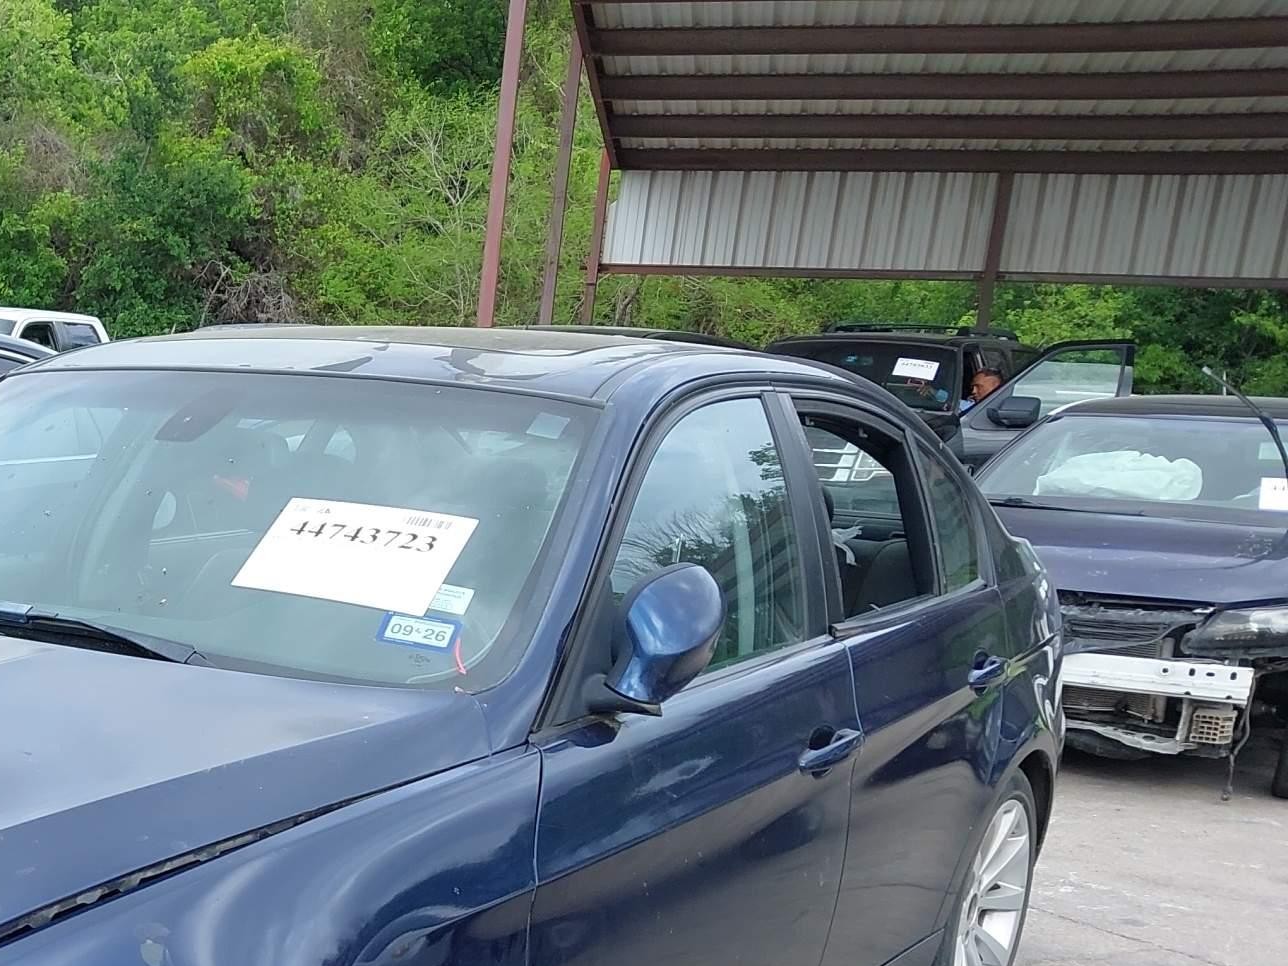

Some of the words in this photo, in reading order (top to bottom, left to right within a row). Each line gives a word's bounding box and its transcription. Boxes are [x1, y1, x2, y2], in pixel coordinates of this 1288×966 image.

[289, 519, 438, 553] 44743723
[390, 622, 414, 637] 09
[422, 627, 448, 643] 26
